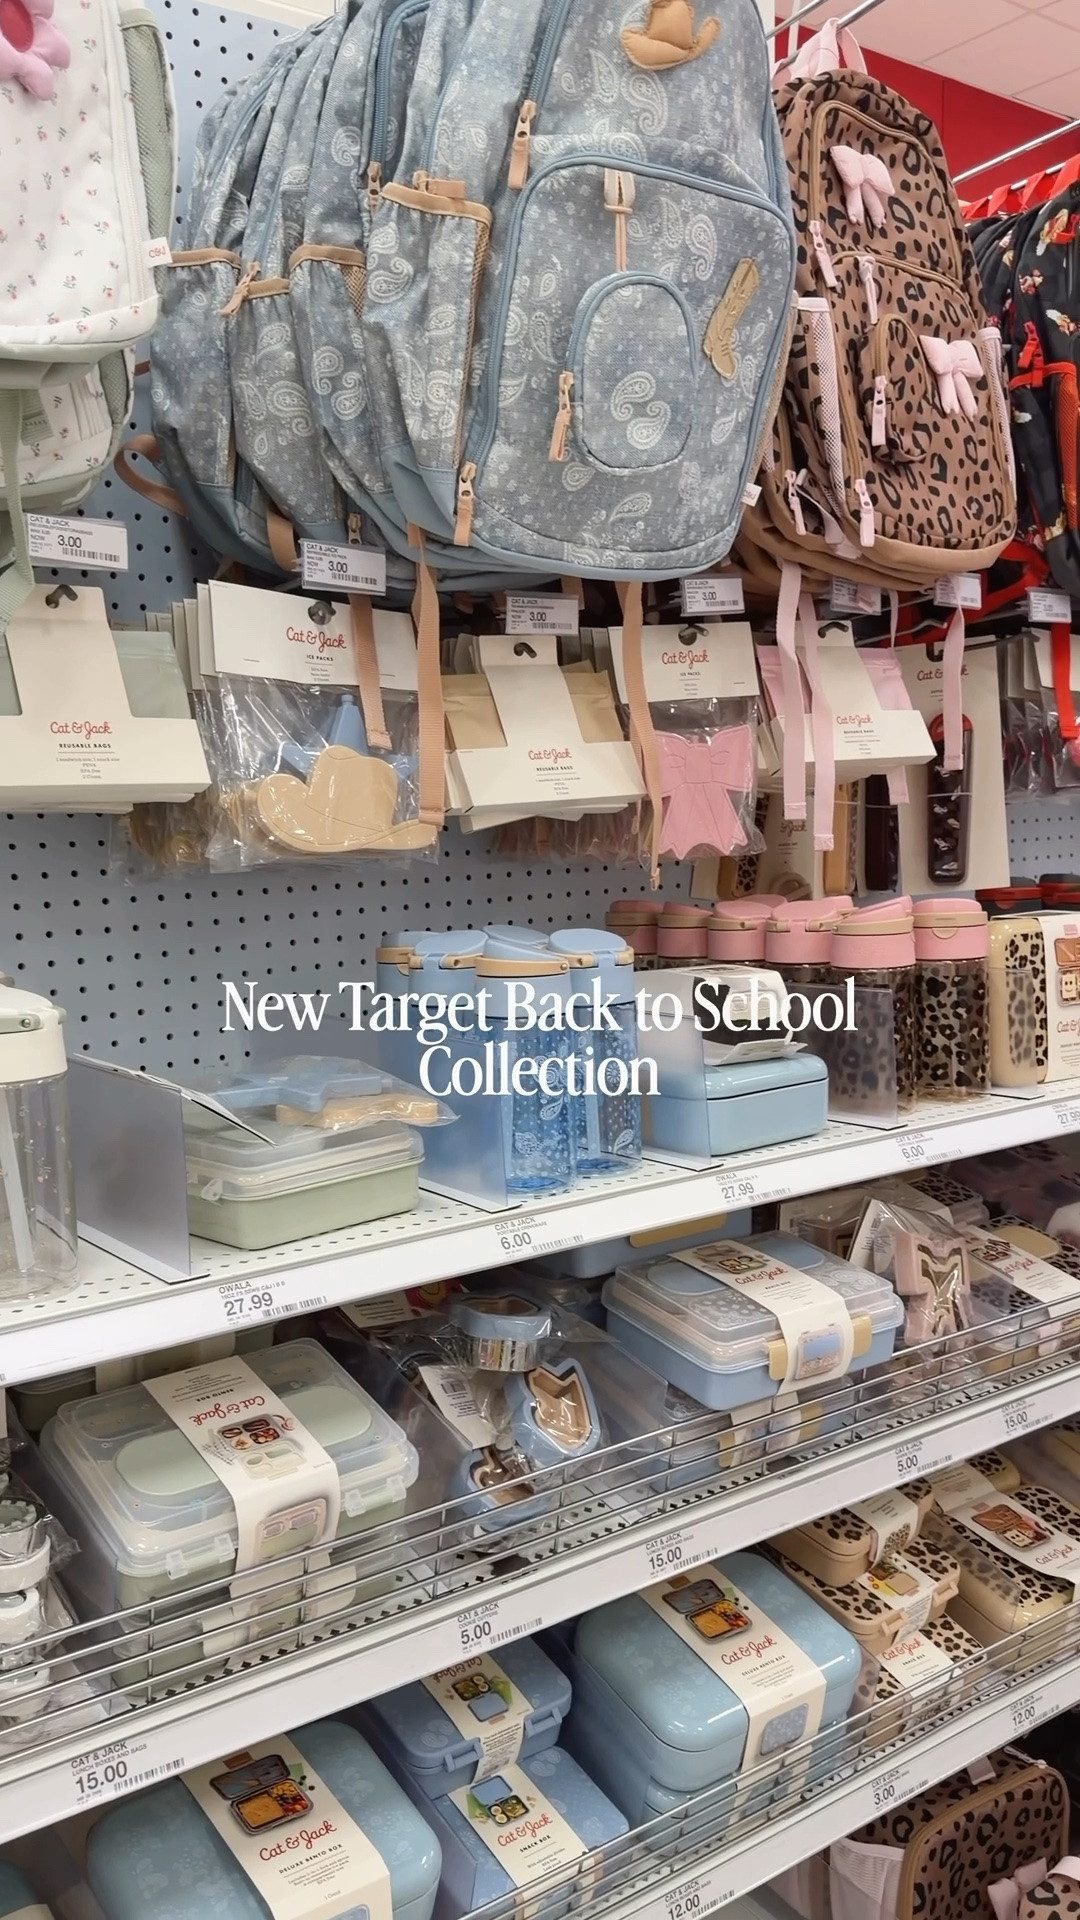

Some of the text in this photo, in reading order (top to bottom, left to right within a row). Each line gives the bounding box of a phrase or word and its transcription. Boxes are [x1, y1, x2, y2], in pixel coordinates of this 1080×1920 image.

[29, 515, 43, 523] CAT
[52, 519, 70, 527] JACK
[57, 535, 82, 548] 3.00
[306, 543, 318, 551] CAT
[324, 546, 339, 554] JACK
[328, 560, 348, 573] 3.00
[702, 591, 717, 601] 3.00
[529, 611, 547, 622] 3.00
[286, 626, 347, 653] Cat & Jack
[661, 649, 710, 670] Cat & Jack
[916, 670, 934, 681] Cat
[50, 720, 112, 740] Cat & Jack
[836, 714, 873, 728] Cat & Jack
[528, 748, 572, 764] Cat & Jack
[901, 1144, 925, 1159] 6.00
[715, 1172, 737, 1182] OWALA
[721, 1182, 754, 1199] 27.99
[494, 1222, 509, 1231] CAT
[516, 1217, 536, 1227] JACK
[500, 1231, 532, 1250] 6.00
[735, 1277, 756, 1285] Cat
[761, 1266, 789, 1281] Jack
[218, 1281, 252, 1295] OWALA
[224, 1291, 274, 1317] 27.99
[188, 1395, 265, 1426] Cat & Jack
[1005, 1411, 1028, 1429] 15.00
[897, 1454, 918, 1472] 5.00
[645, 1540, 658, 1550] CAT
[665, 1531, 682, 1543] JACK
[649, 1546, 682, 1570] 15.00
[457, 1601, 500, 1623] CAT & JACK
[461, 1620, 492, 1645] 5.00
[721, 1635, 778, 1666] Cat & Jack
[882, 1638, 924, 1660] Cat & Jack
[1012, 1706, 1035, 1726] 12.00
[71, 1741, 128, 1769] CAT & JACK
[72, 1743, 148, 1776] LUNCH BOXES AND BAGS
[75, 1760, 128, 1794] 15.00
[874, 1784, 895, 1805] 3.00
[497, 1813, 553, 1847] Cat & Jack
[259, 1820, 338, 1861] Cat & Jack
[520, 1835, 551, 1853] SNACK BOX
[279, 1843, 343, 1874] DELUXE BENTO BOX
[664, 1891, 678, 1903] CAT
[683, 1880, 700, 1893] JACK
[668, 1894, 700, 1920] 12.00
